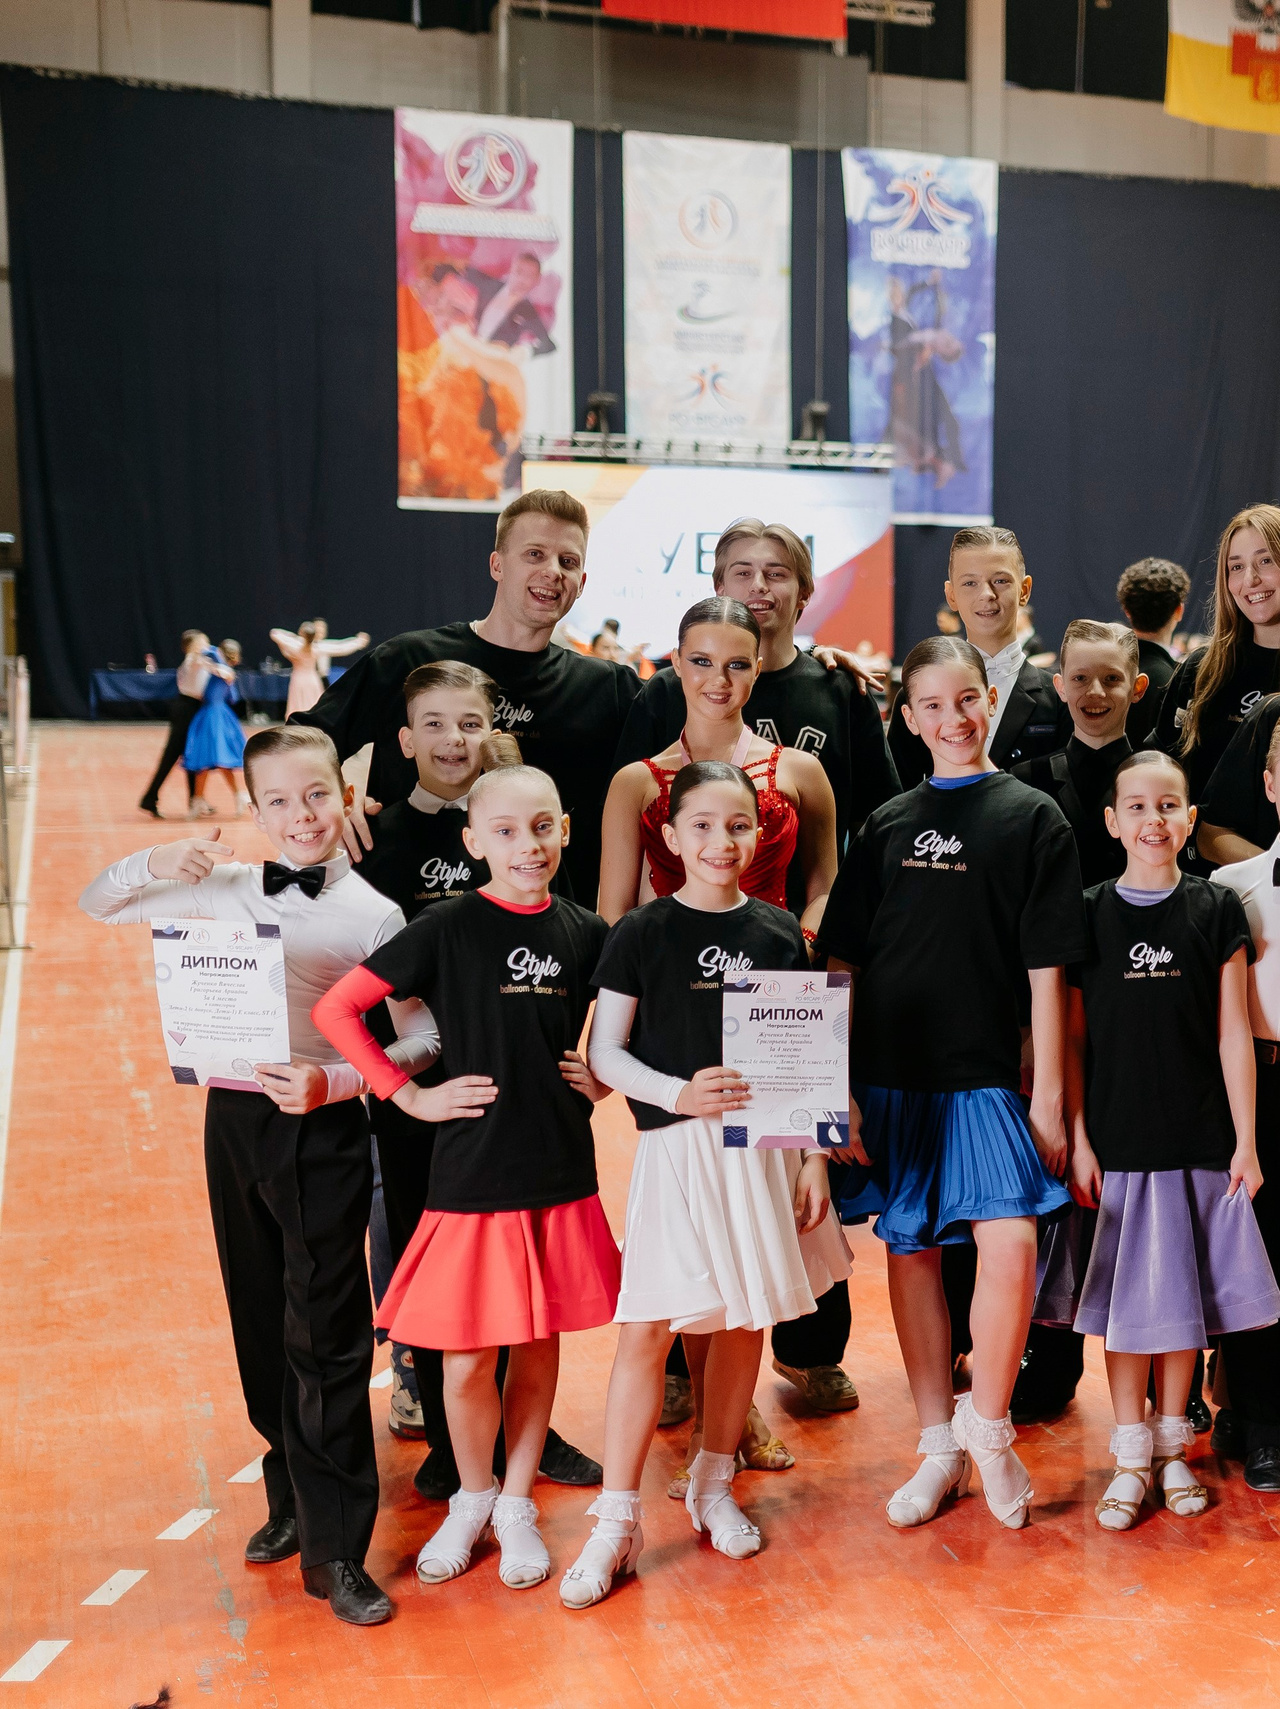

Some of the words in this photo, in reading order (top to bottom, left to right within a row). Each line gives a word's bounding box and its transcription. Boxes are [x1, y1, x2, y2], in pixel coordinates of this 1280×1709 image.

[913, 829, 963, 861] Style
[902, 858, 927, 868] ballroom
[931, 860, 949, 870] dance
[954, 862, 967, 872] club
[419, 857, 471, 889] Style
[414, 891, 441, 900] ballroom
[181, 954, 258, 971] ДИПЛОМ
[697, 945, 753, 978] Style
[1129, 942, 1173, 971] Style
[506, 947, 562, 985] Style
[1123, 971, 1146, 979] ballroom
[1150, 969, 1166, 978] dance
[499, 984, 530, 994] ballroom
[534, 984, 553, 995] dance
[689, 981, 719, 990] ballroom
[749, 1008, 823, 1021] ДИПЛОМ
